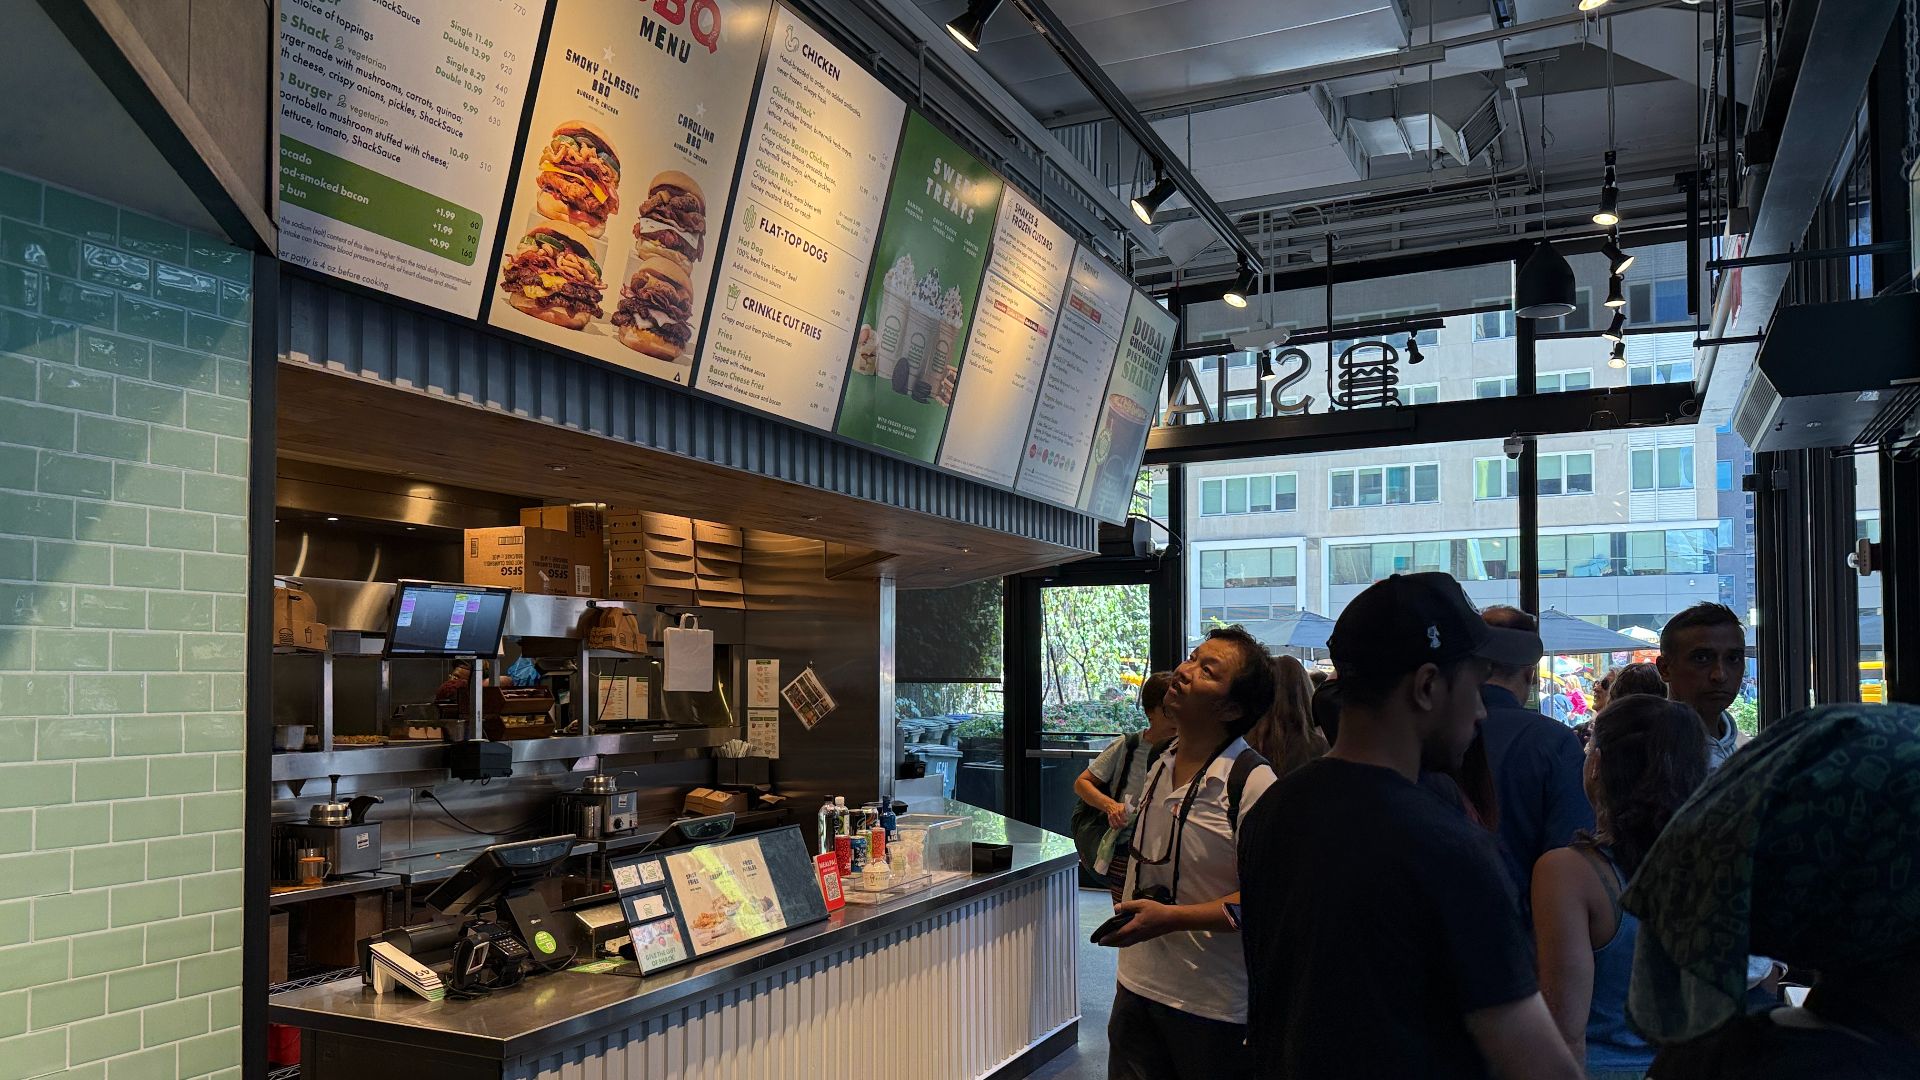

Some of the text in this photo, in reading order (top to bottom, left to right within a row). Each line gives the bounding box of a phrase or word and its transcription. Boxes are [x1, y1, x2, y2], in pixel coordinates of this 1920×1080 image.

[325, 11, 374, 40] of toppings
[372, 0, 421, 25] ackSauce
[513, 3, 526, 16] 770
[639, 0, 721, 54] BQ
[291, 14, 330, 43] Shack
[348, 46, 387, 70] vegetarian
[443, 31, 512, 76] Double 13.99 920
[450, 20, 515, 62] Single 11.49 670
[640, 16, 691, 63] MENU
[308, 44, 333, 61] made
[336, 55, 353, 72] with
[355, 66, 404, 96] mushrooms,
[406, 91, 434, 110] carrots,
[446, 56, 468, 74] Single
[469, 69, 486, 82] 8.29
[565, 48, 641, 100] SMOKY CLASSIC
[802, 44, 840, 81] CHICKEN
[292, 53, 326, 76] cheese,
[329, 71, 355, 88] crispy
[357, 84, 385, 104] onions,
[388, 98, 416, 118] pickles,
[420, 110, 464, 138] ShackSauce
[435, 66, 462, 86] Double
[464, 80, 482, 95] 10.99
[592, 79, 611, 98] BBQ
[772, 85, 795, 106] Chicken
[288, 72, 388, 126] Burger vegetarian
[577, 88, 595, 103] BURGER
[600, 101, 619, 116] CHICKEN
[280, 90, 327, 115] portobello
[330, 111, 373, 135] mushroom
[375, 131, 402, 148] stuffed
[405, 144, 420, 156] with
[462, 102, 478, 115] 9.99
[281, 104, 313, 128] lettuce,
[316, 121, 349, 142] tomato,
[352, 134, 401, 162] ShackSauce
[449, 147, 469, 161] 10.49
[678, 113, 715, 144] CAROLINA
[686, 132, 702, 150] BBQ
[764, 122, 830, 170] Avocado Bacon Chicken
[755, 159, 779, 178] Chicken
[280, 148, 480, 230] ocado +1.99 60
[926, 177, 975, 225] TREATS
[287, 183, 307, 199] bun
[429, 238, 450, 250] +0.99
[461, 248, 473, 259] 160
[341, 187, 370, 205] bacon
[432, 222, 453, 236] +1.99
[467, 235, 477, 245] 90
[1015, 203, 1034, 223] SHAKES
[337, 245, 353, 256] blood
[738, 236, 764, 256] Hot Dog
[760, 217, 828, 263] FLAT-TOP DOGS
[1011, 215, 1032, 237] FROZEN
[1032, 230, 1052, 251] CUSTARD
[290, 253, 389, 291] patty is 4 oz before cooking
[717, 328, 733, 340] Fries
[742, 296, 822, 341] CRINKLE CUT FRIES
[1132, 315, 1166, 354] DUBAI
[714, 341, 752, 362] Cheese Fries
[1127, 348, 1158, 377] PISTACHIO
[1130, 335, 1162, 366] CHOCOLATE
[709, 364, 765, 391] Bacon Cheese Fries
[1122, 360, 1156, 394] SHAKE
[501, 566, 523, 576] SFSG
[548, 569, 568, 579] SFSG
